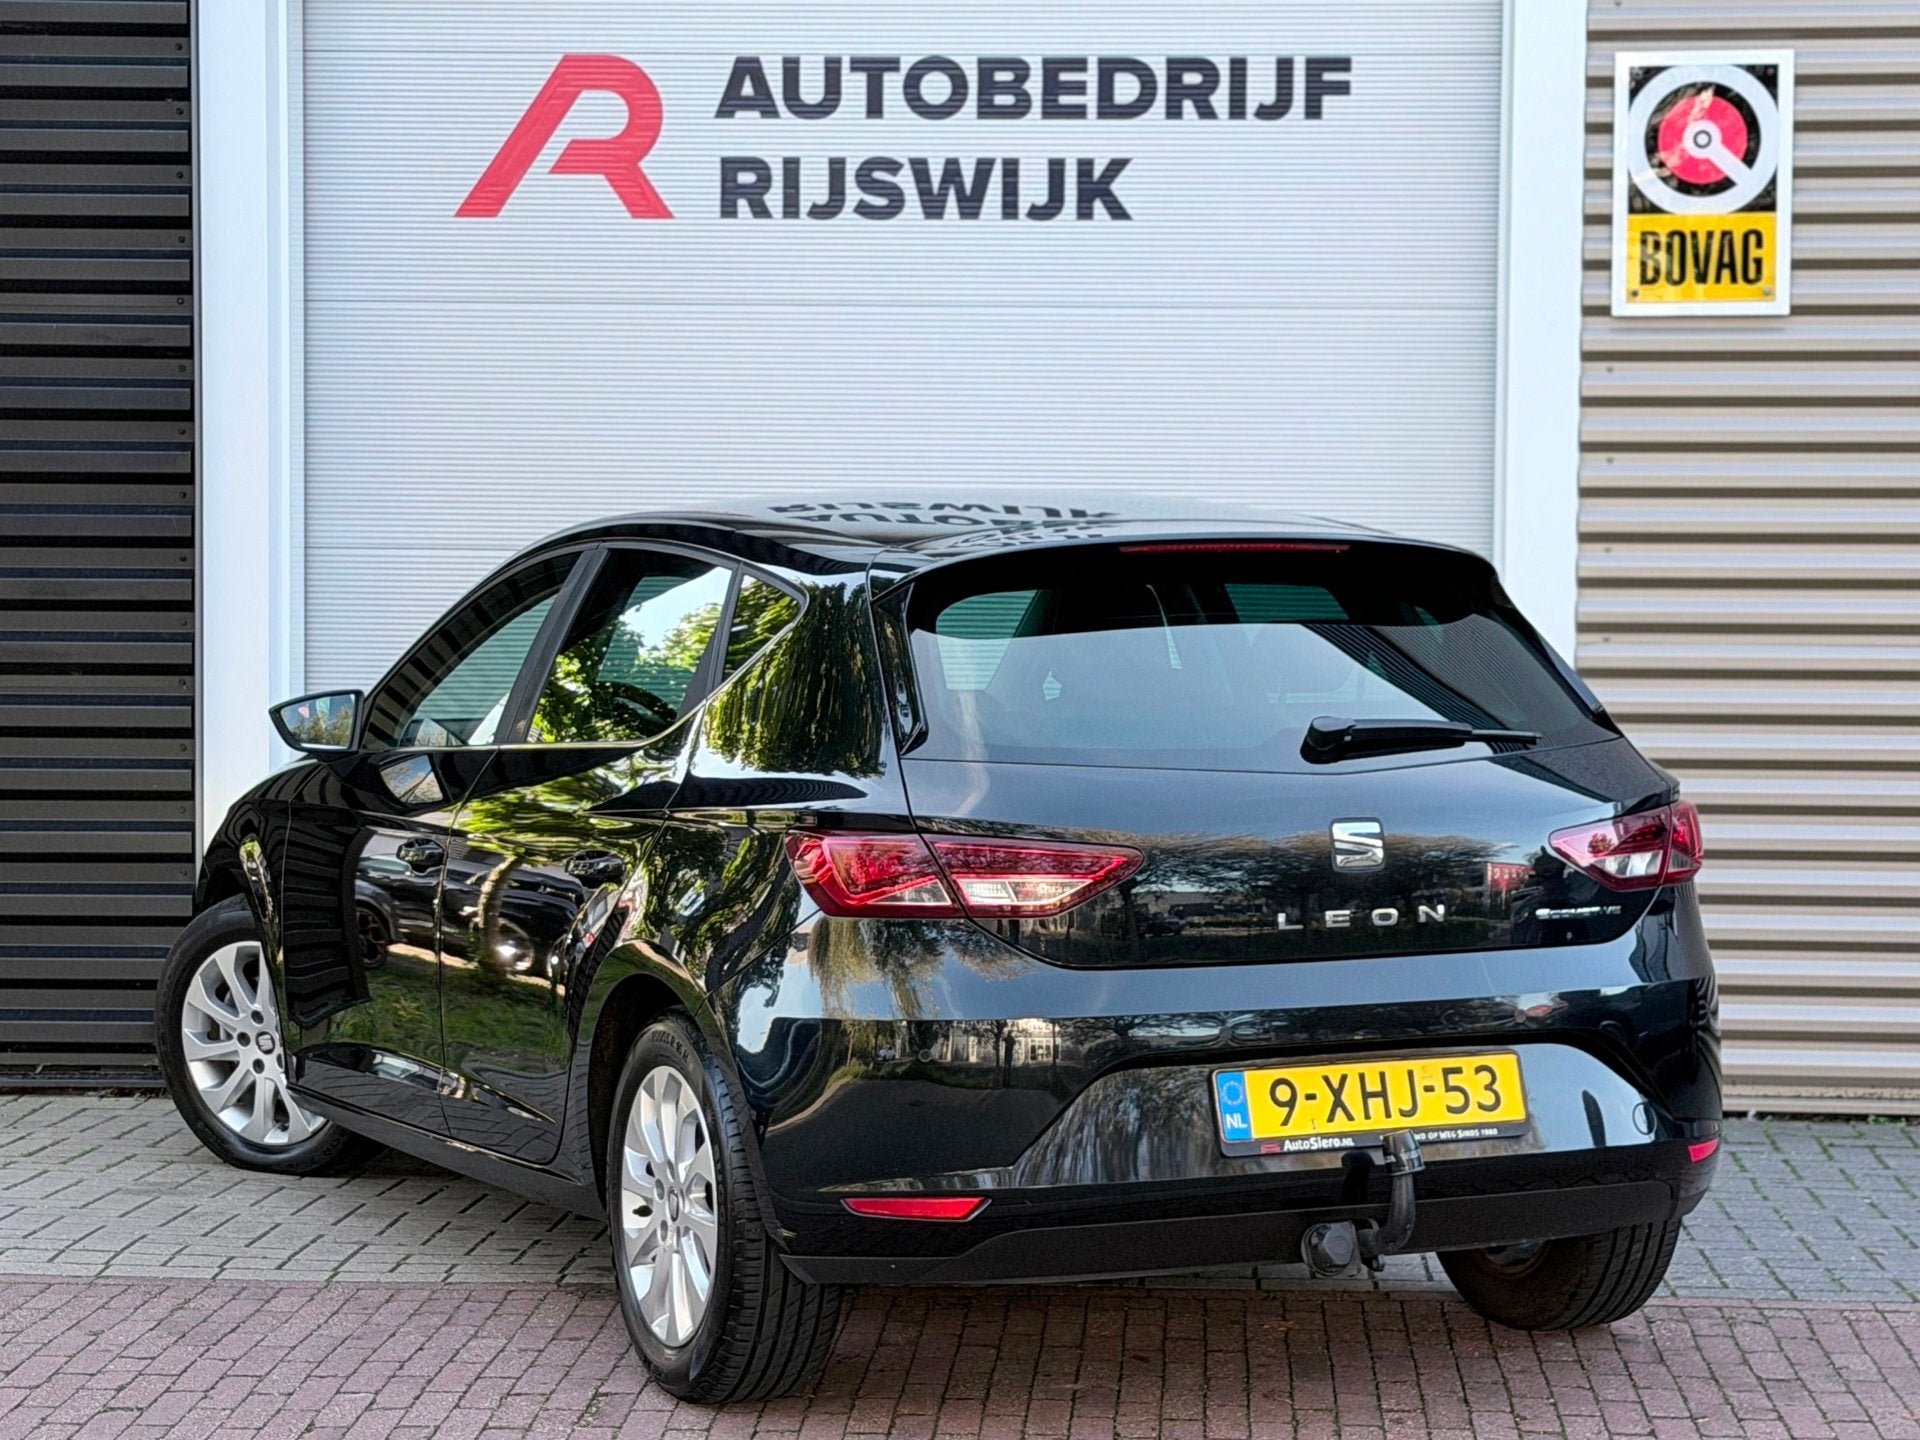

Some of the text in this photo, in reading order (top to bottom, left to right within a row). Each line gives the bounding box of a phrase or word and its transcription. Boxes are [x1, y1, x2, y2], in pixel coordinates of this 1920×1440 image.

[714, 55, 1352, 120] AUTOBEDRIJF
[720, 156, 1134, 220] RIJSWIJK
[1639, 229, 1764, 286] BOVAG
[1277, 904, 1445, 930] LEON
[1225, 1113, 1248, 1129] NL
[1269, 1064, 1502, 1127] 9-XHJ-53
